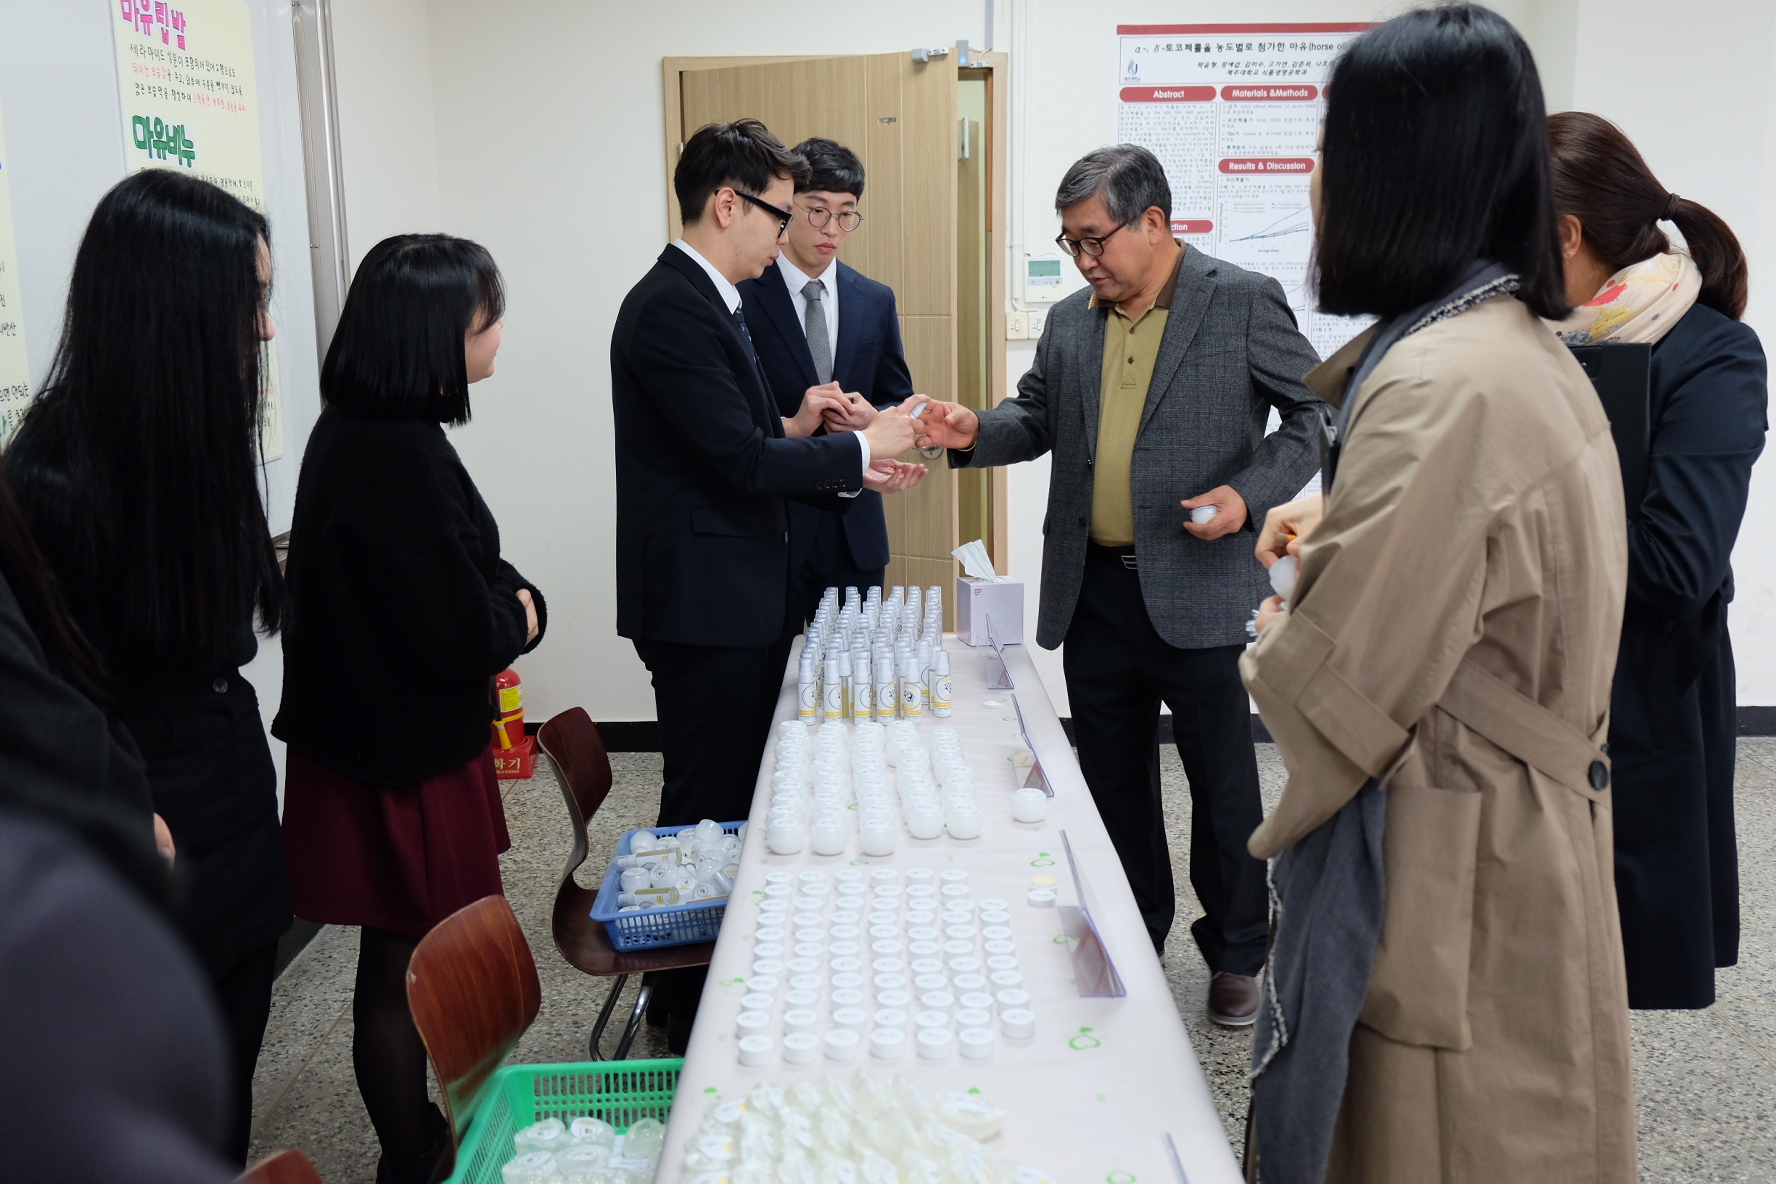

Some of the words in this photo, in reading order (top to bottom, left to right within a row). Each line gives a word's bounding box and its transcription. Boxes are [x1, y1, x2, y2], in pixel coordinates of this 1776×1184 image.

[1216, 42, 1254, 53] 농도별로
[1258, 42, 1285, 52] 첨가한
[1153, 90, 1184, 98] Abstract
[1232, 89, 1267, 98] Materials
[1269, 89, 1308, 97] &Methods
[132, 115, 195, 168] 마유비누
[1229, 162, 1256, 170] Results
[1258, 162, 1264, 170] &
[1267, 162, 1306, 170] Discussion
